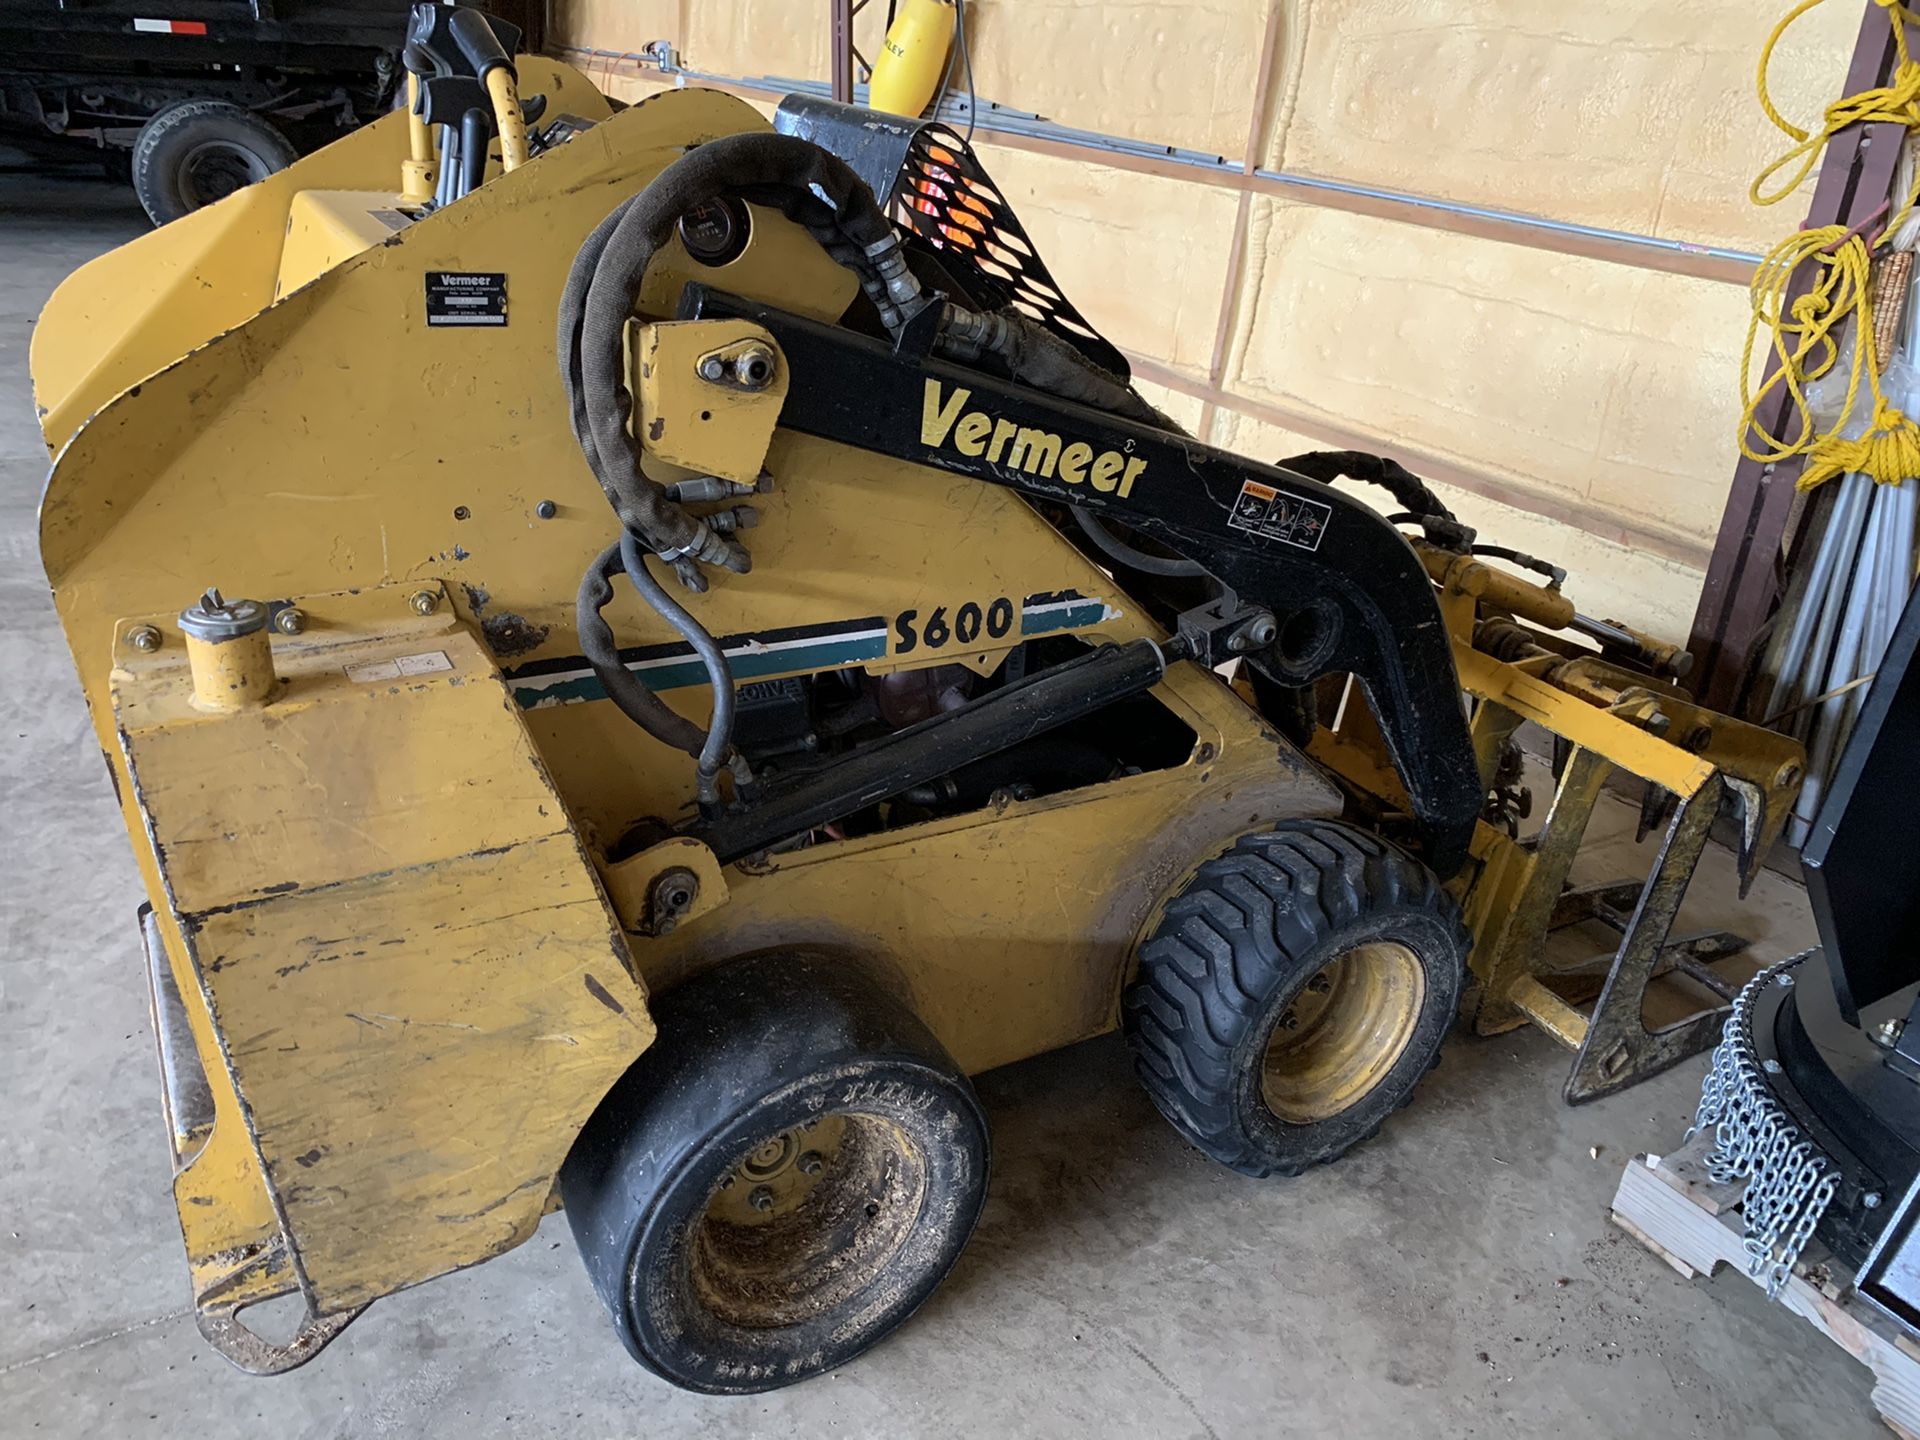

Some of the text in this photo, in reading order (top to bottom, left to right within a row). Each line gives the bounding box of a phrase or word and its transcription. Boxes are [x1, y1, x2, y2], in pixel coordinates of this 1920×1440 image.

[885, 39, 904, 57] LEY
[441, 274, 491, 286] Vermeer
[920, 378, 1148, 498] Vermeer
[895, 597, 1014, 654] S600
